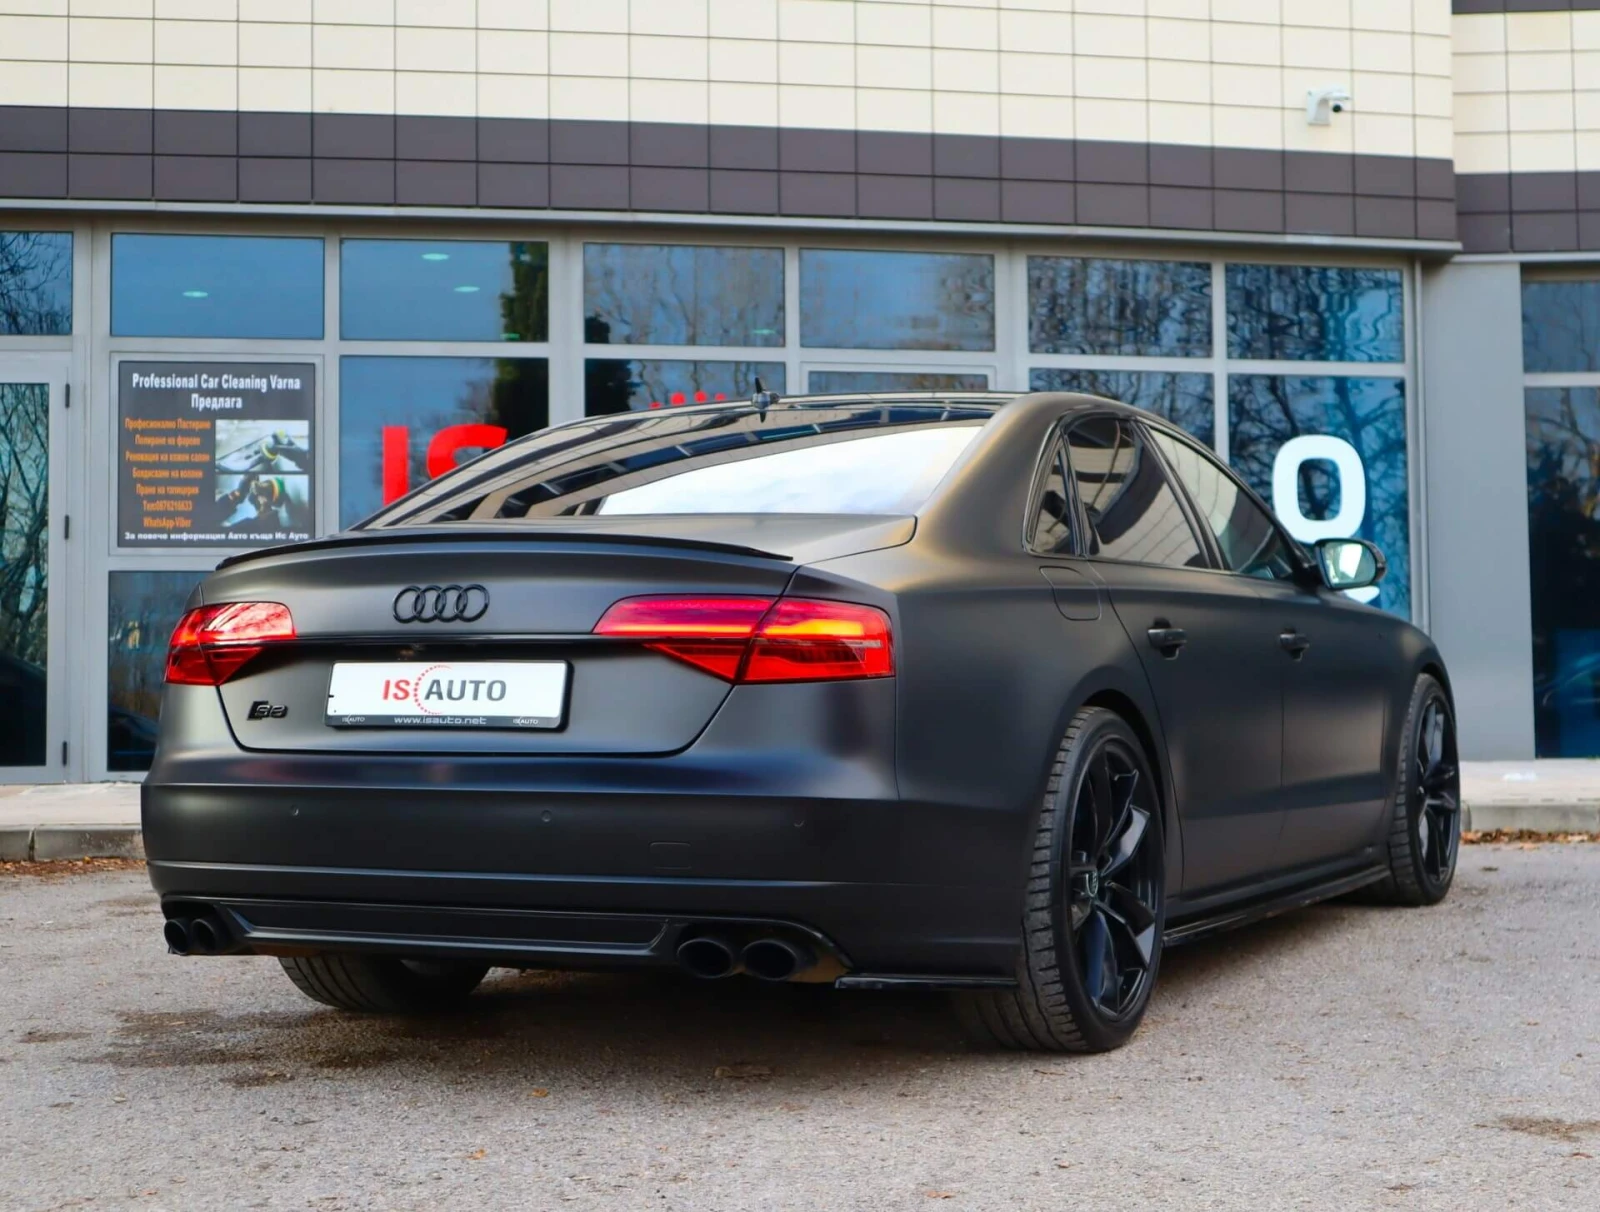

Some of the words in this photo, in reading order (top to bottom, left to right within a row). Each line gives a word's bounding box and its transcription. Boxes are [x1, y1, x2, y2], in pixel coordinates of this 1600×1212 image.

[132, 372, 198, 388] Professional
[201, 373, 219, 389] Car
[221, 374, 267, 392] Cleaning
[270, 374, 301, 390] Varna
[191, 393, 243, 411] Предлага
[382, 679, 411, 701] IS
[424, 679, 507, 702] AUTO
[394, 716, 487, 725] www.isauto.net
